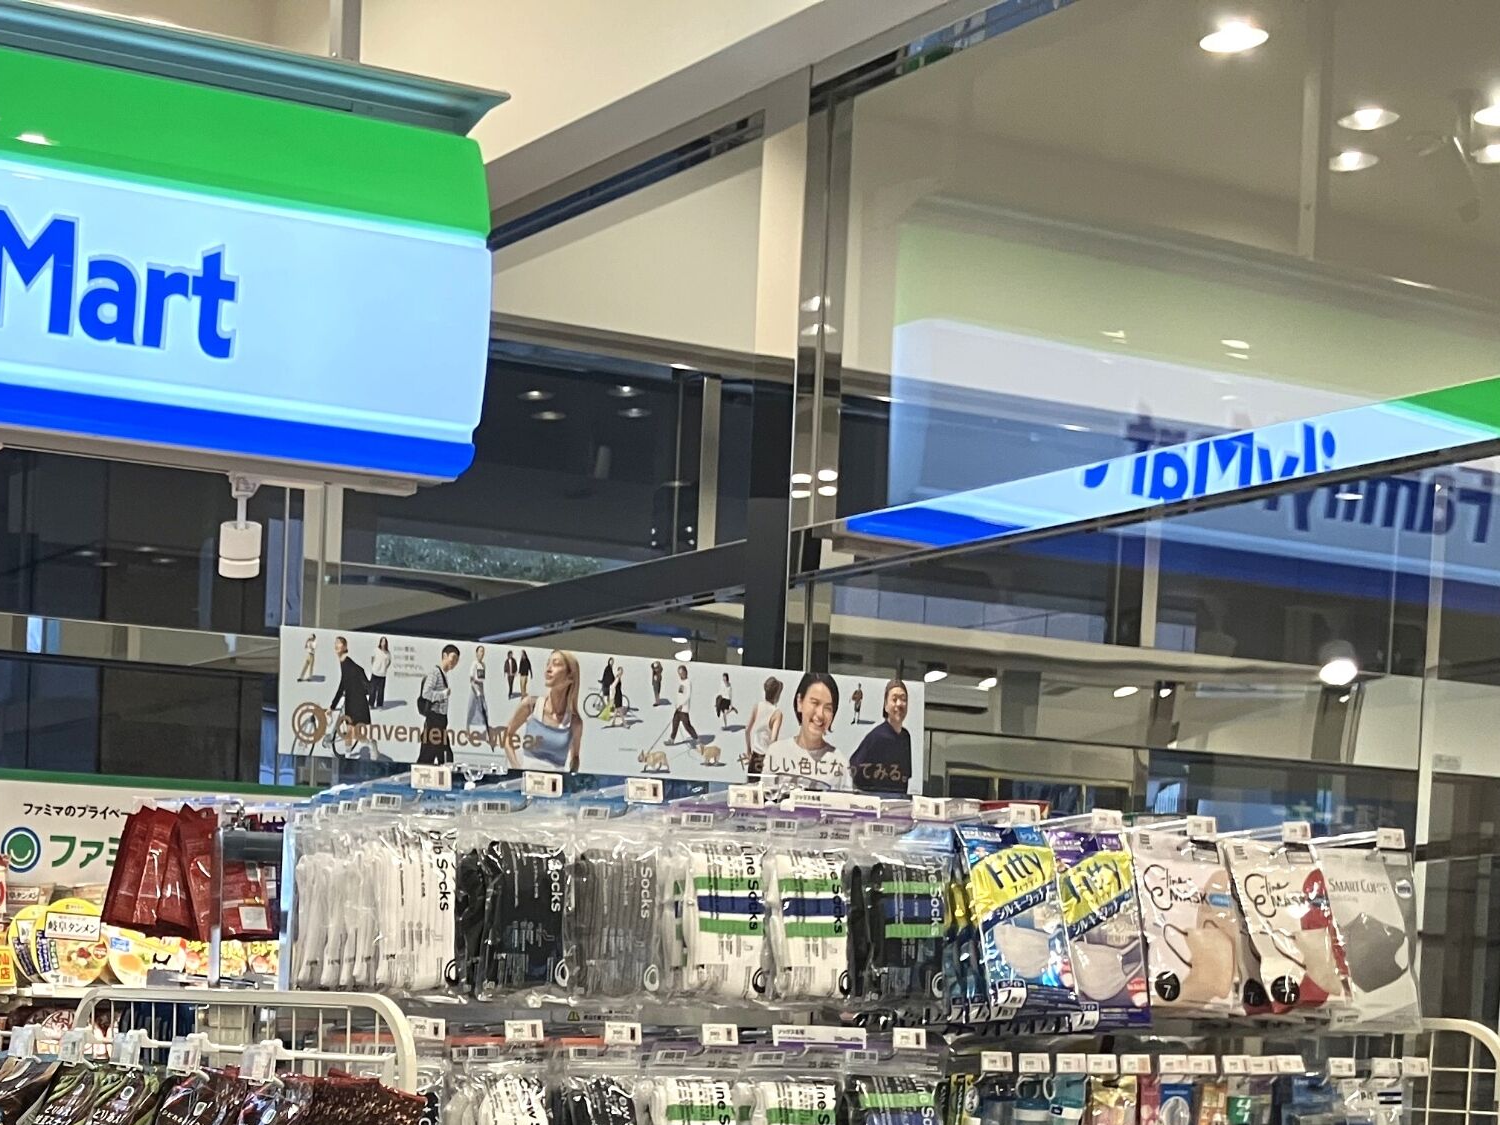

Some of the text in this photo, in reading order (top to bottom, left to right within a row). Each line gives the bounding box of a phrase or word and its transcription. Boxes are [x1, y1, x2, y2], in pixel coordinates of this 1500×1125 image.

[337, 713, 543, 752] Convenience Wear
[434, 855, 450, 911] Socks
[985, 846, 1045, 890] Fitty
[639, 865, 654, 920] Socks
[747, 879, 759, 931] Socks
[1169, 890, 1211, 907] MASK
